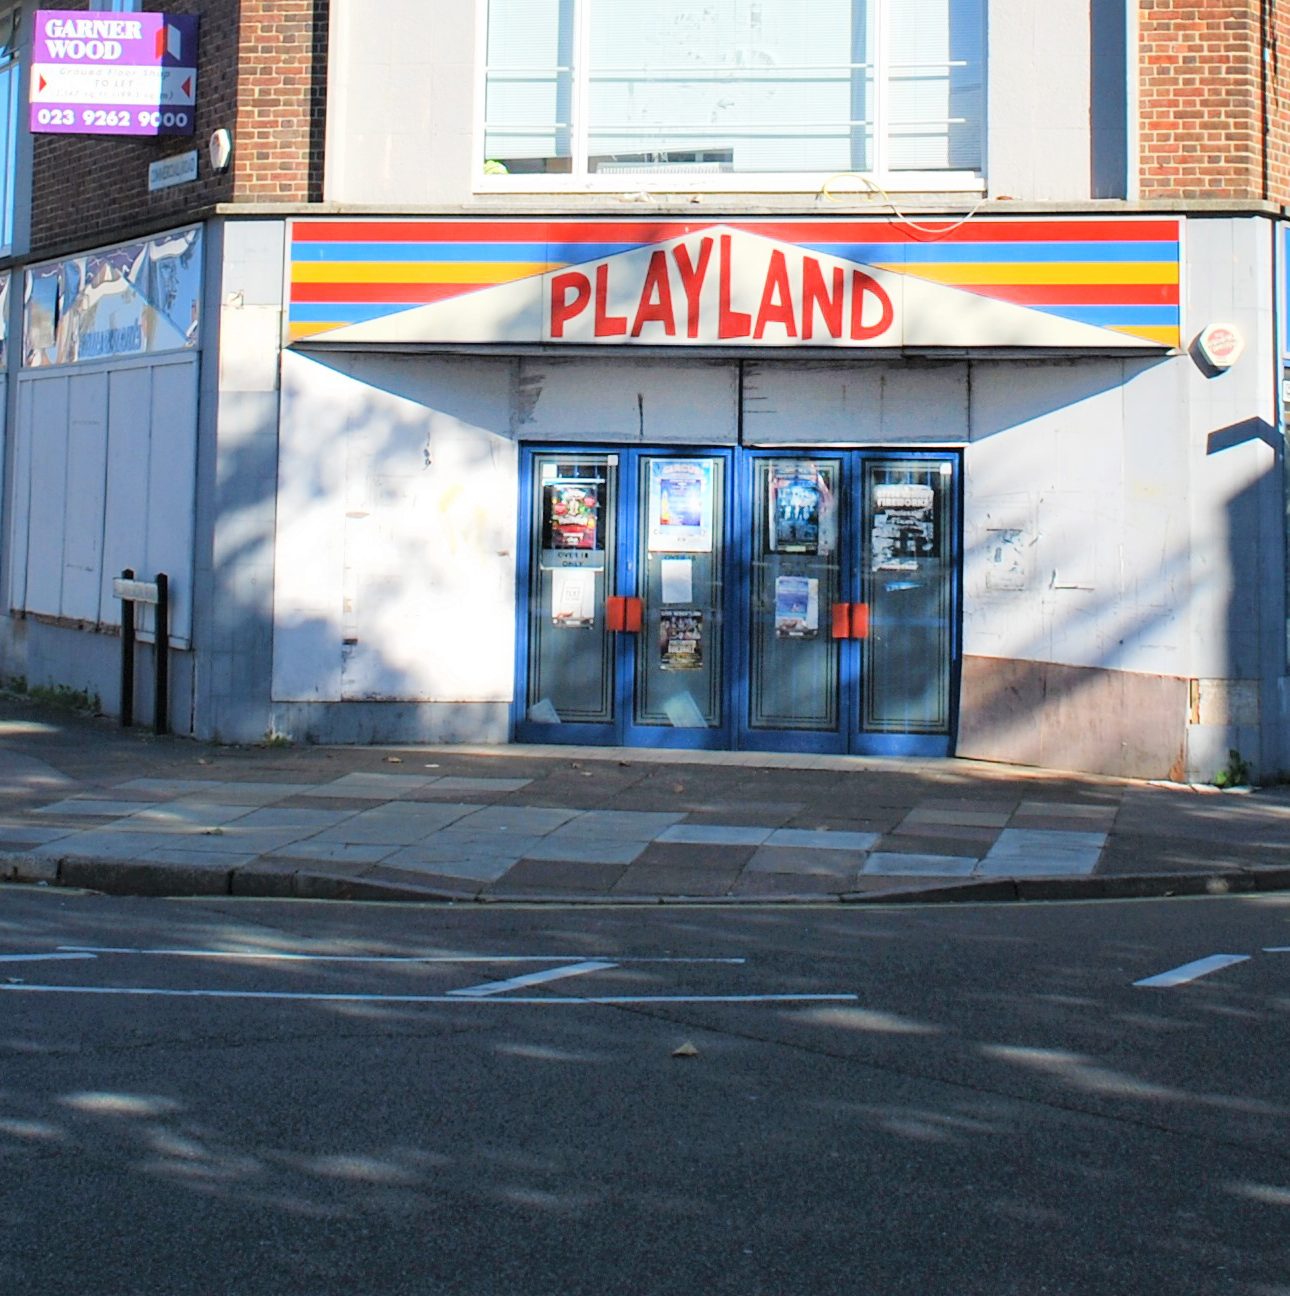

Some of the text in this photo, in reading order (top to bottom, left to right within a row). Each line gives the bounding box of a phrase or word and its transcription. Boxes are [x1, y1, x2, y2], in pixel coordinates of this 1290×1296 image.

[45, 19, 143, 40] GARNER
[45, 39, 122, 60] WOOD
[94, 79, 134, 88] TO LET
[37, 109, 188, 128] 023 9262 9000
[551, 234, 894, 340] PLAYLAND
